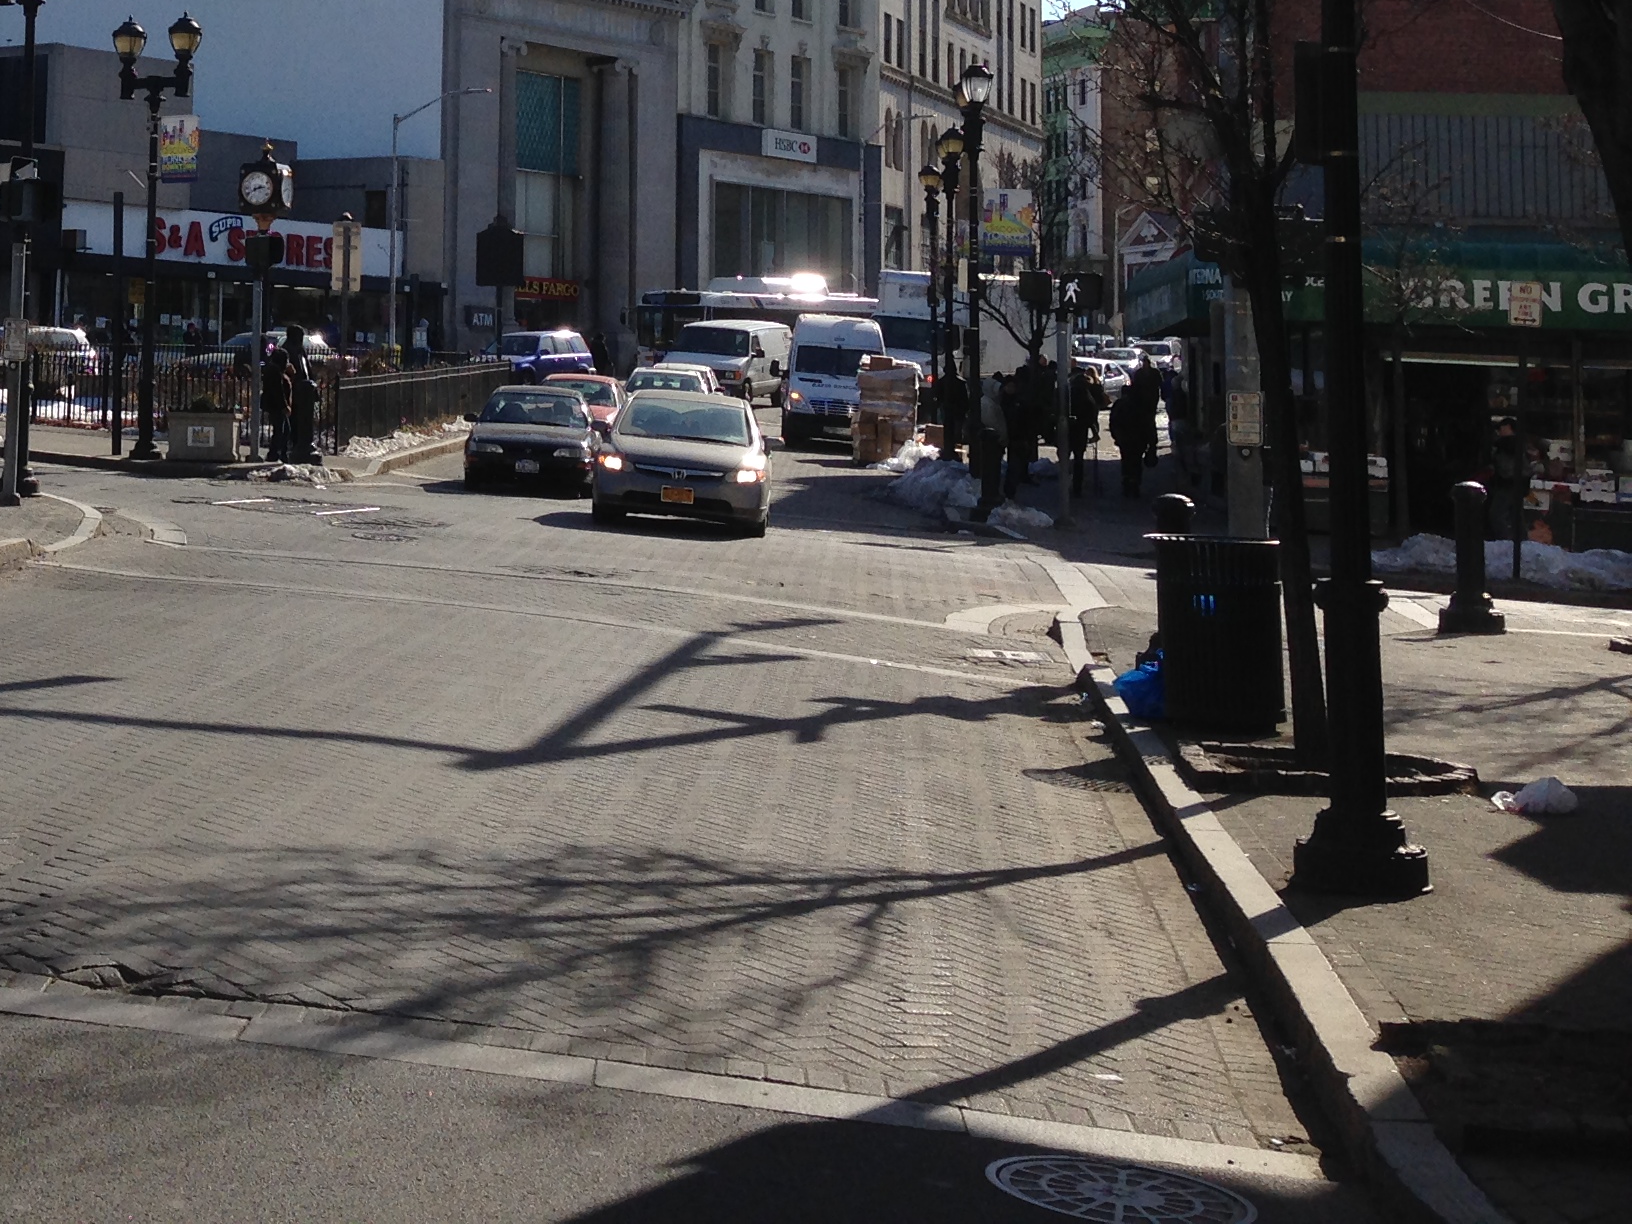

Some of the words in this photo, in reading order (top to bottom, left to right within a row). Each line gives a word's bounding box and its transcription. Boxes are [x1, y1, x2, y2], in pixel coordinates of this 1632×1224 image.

[774, 137, 798, 153] HSBC
[211, 216, 243, 238] SUPER
[542, 281, 580, 297] FARGO
[1519, 285, 1533, 295] NO
[472, 312, 494, 326] ATM
